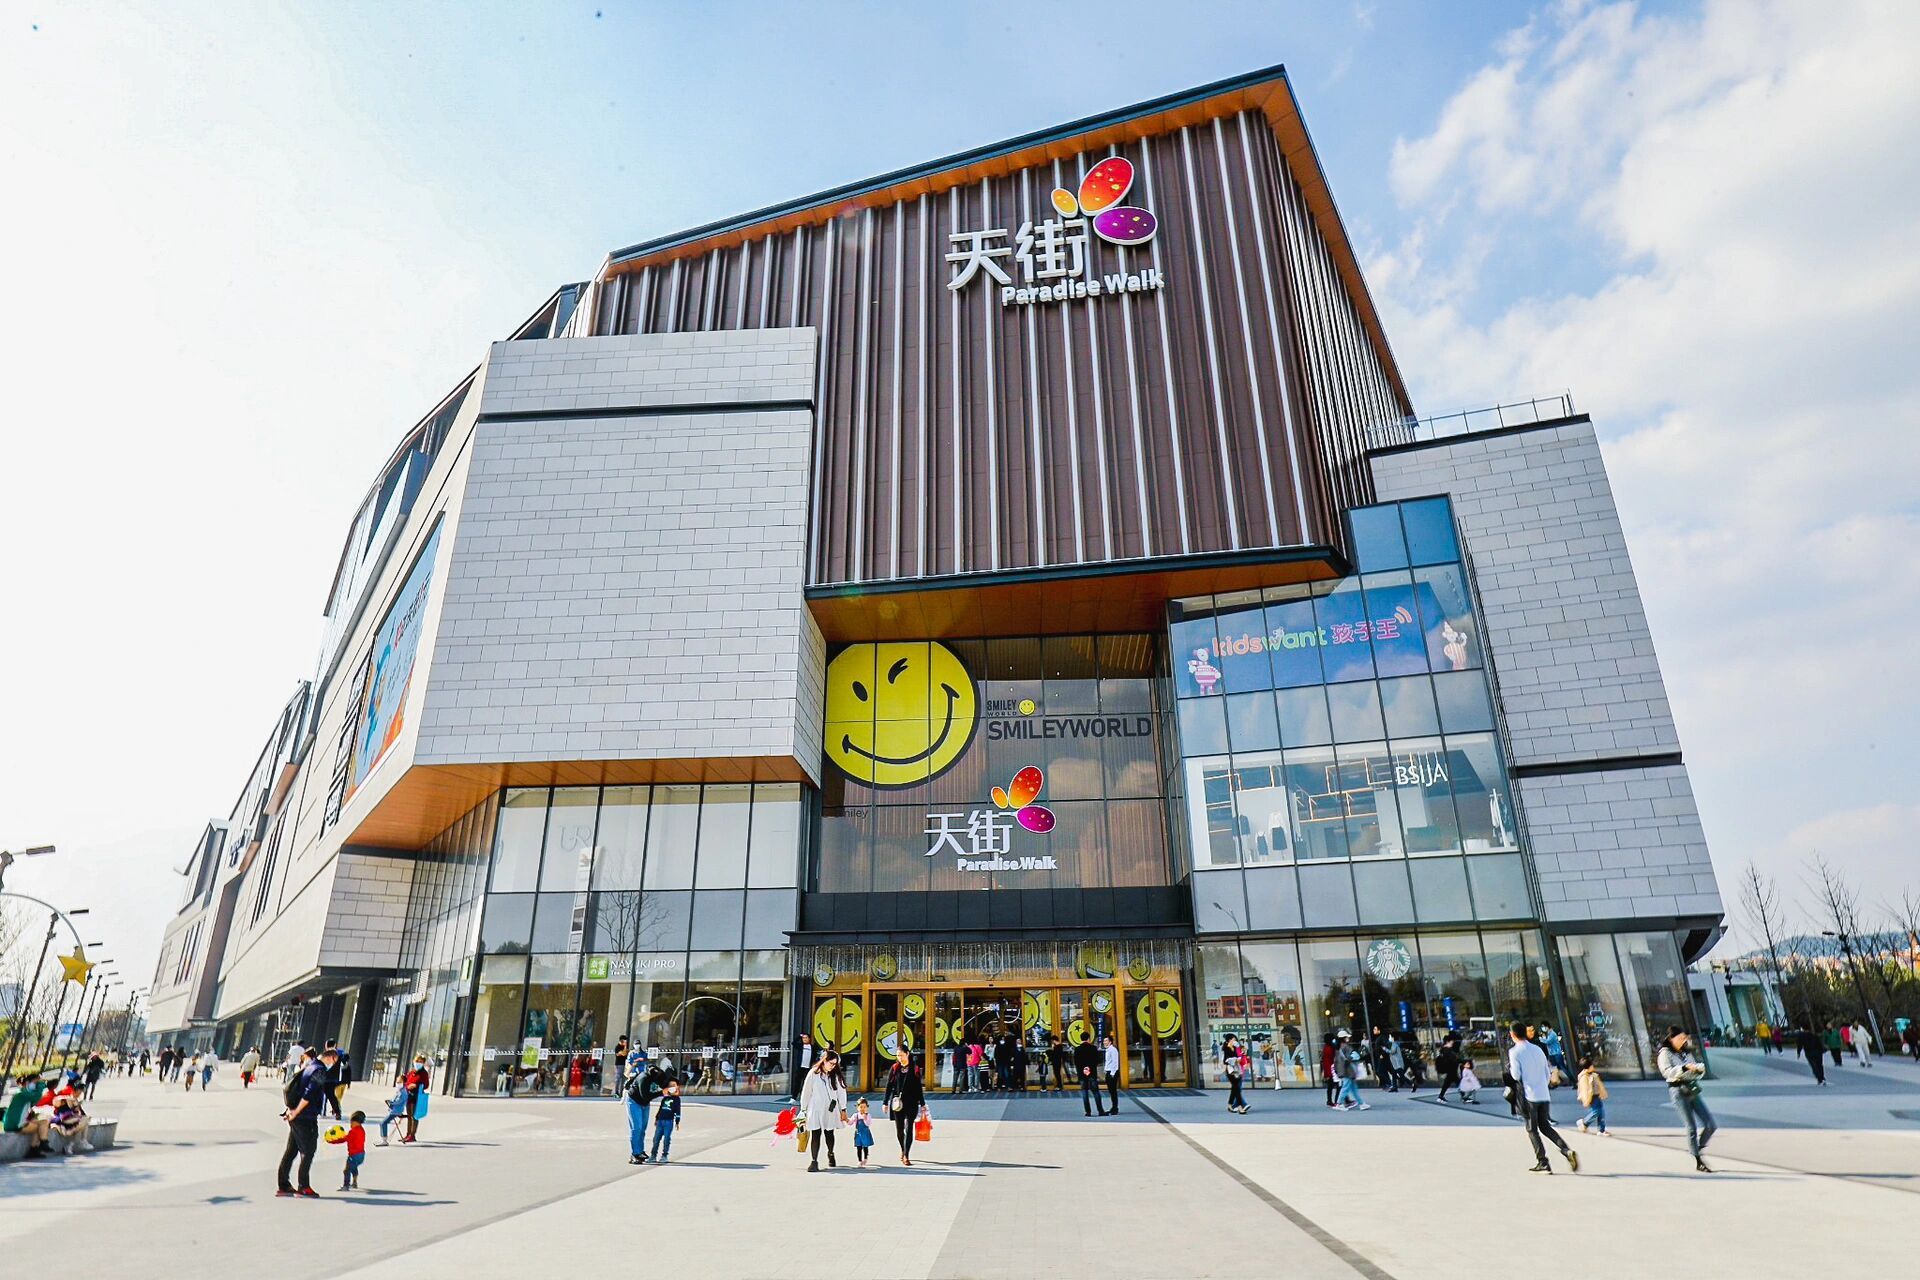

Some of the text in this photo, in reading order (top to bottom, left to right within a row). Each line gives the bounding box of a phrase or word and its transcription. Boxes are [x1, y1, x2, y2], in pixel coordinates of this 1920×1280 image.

[945, 218, 1087, 290] 天街
[1001, 269, 1165, 306] Paradise Walk
[1212, 627, 1327, 657] kidswant
[1331, 618, 1400, 645] 孩子王
[987, 700, 1017, 711] SMILEY
[988, 718, 1151, 740] SMILEYWORLD
[923, 809, 1015, 857] 天街
[957, 855, 1058, 871] Paradise Walk
[654, 959, 676, 968] PRO
